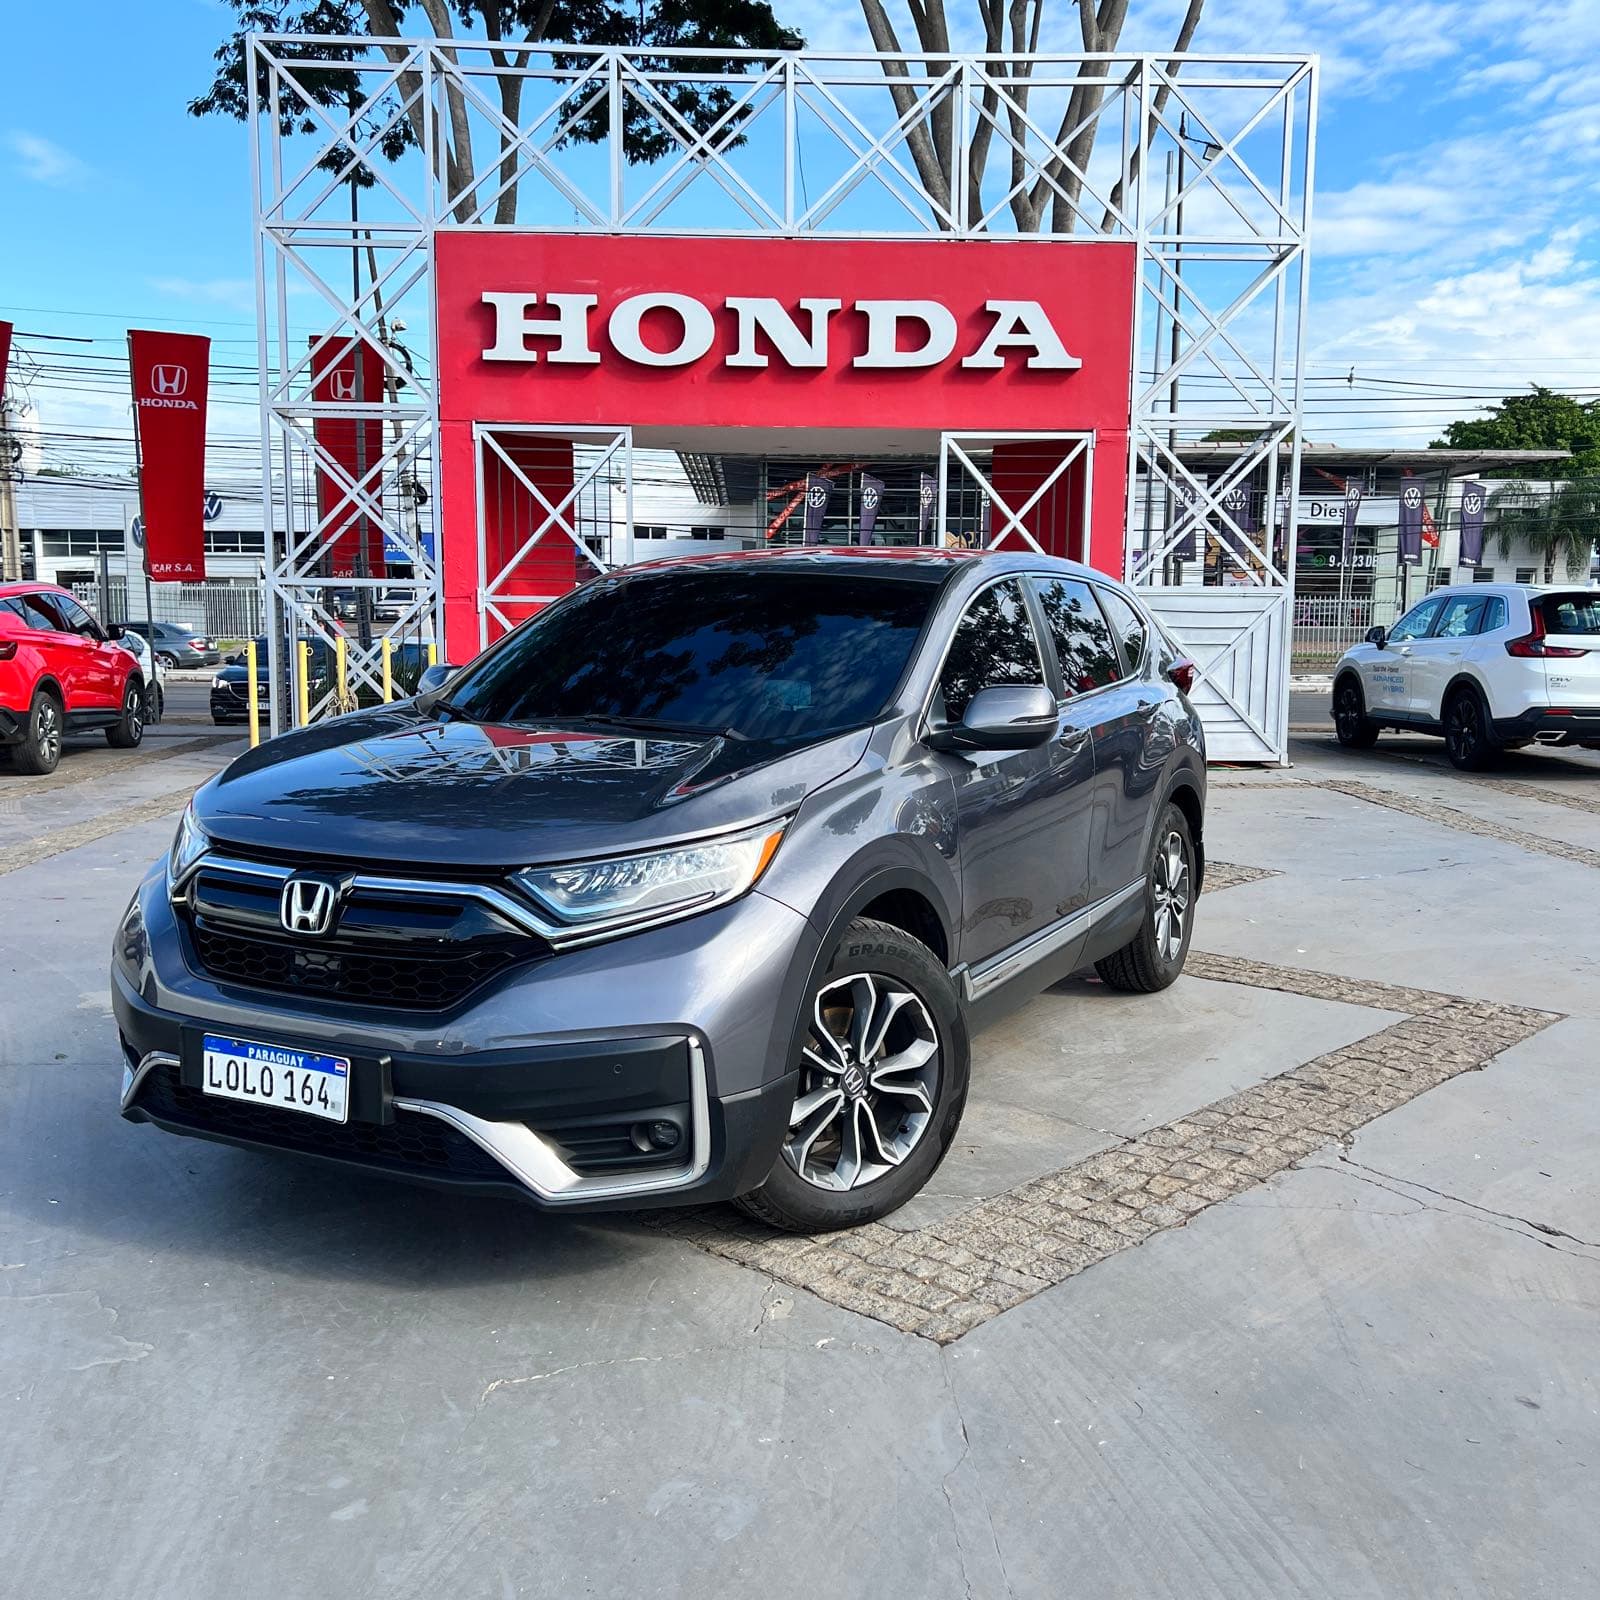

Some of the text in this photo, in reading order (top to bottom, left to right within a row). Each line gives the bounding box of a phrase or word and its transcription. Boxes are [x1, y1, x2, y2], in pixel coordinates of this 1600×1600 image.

[481, 291, 1083, 368] HONDA
[140, 398, 199, 410] HONDA
[248, 1047, 304, 1067] PARAGUAY
[209, 1055, 329, 1110] LOLO 164
